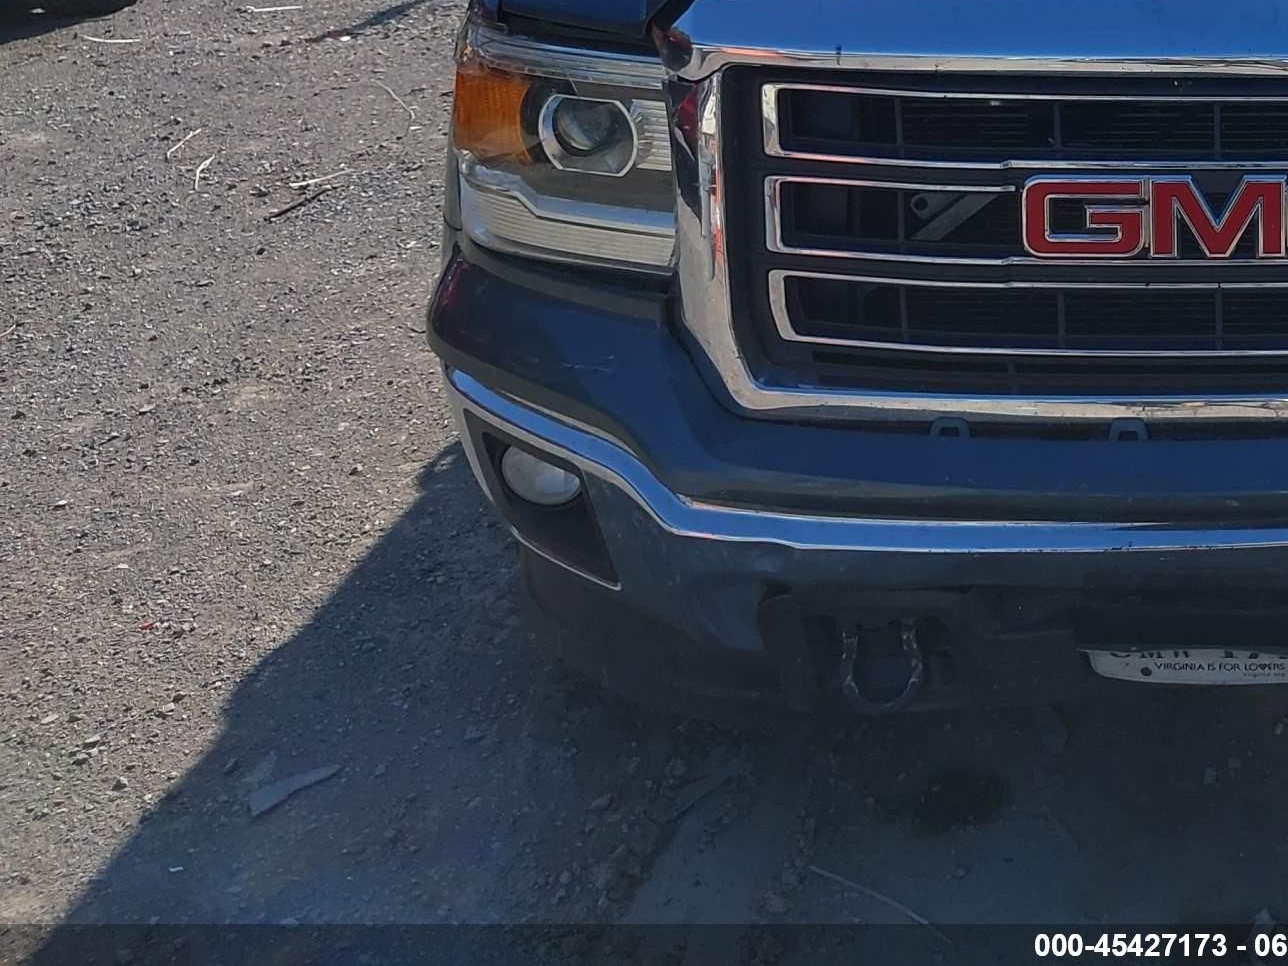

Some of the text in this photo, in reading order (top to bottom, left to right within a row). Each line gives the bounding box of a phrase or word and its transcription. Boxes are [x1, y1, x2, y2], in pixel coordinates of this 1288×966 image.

[1154, 662, 1205, 671] VIRGINIA
[1207, 663, 1217, 671] IS
[1219, 663, 1241, 671] FOR
